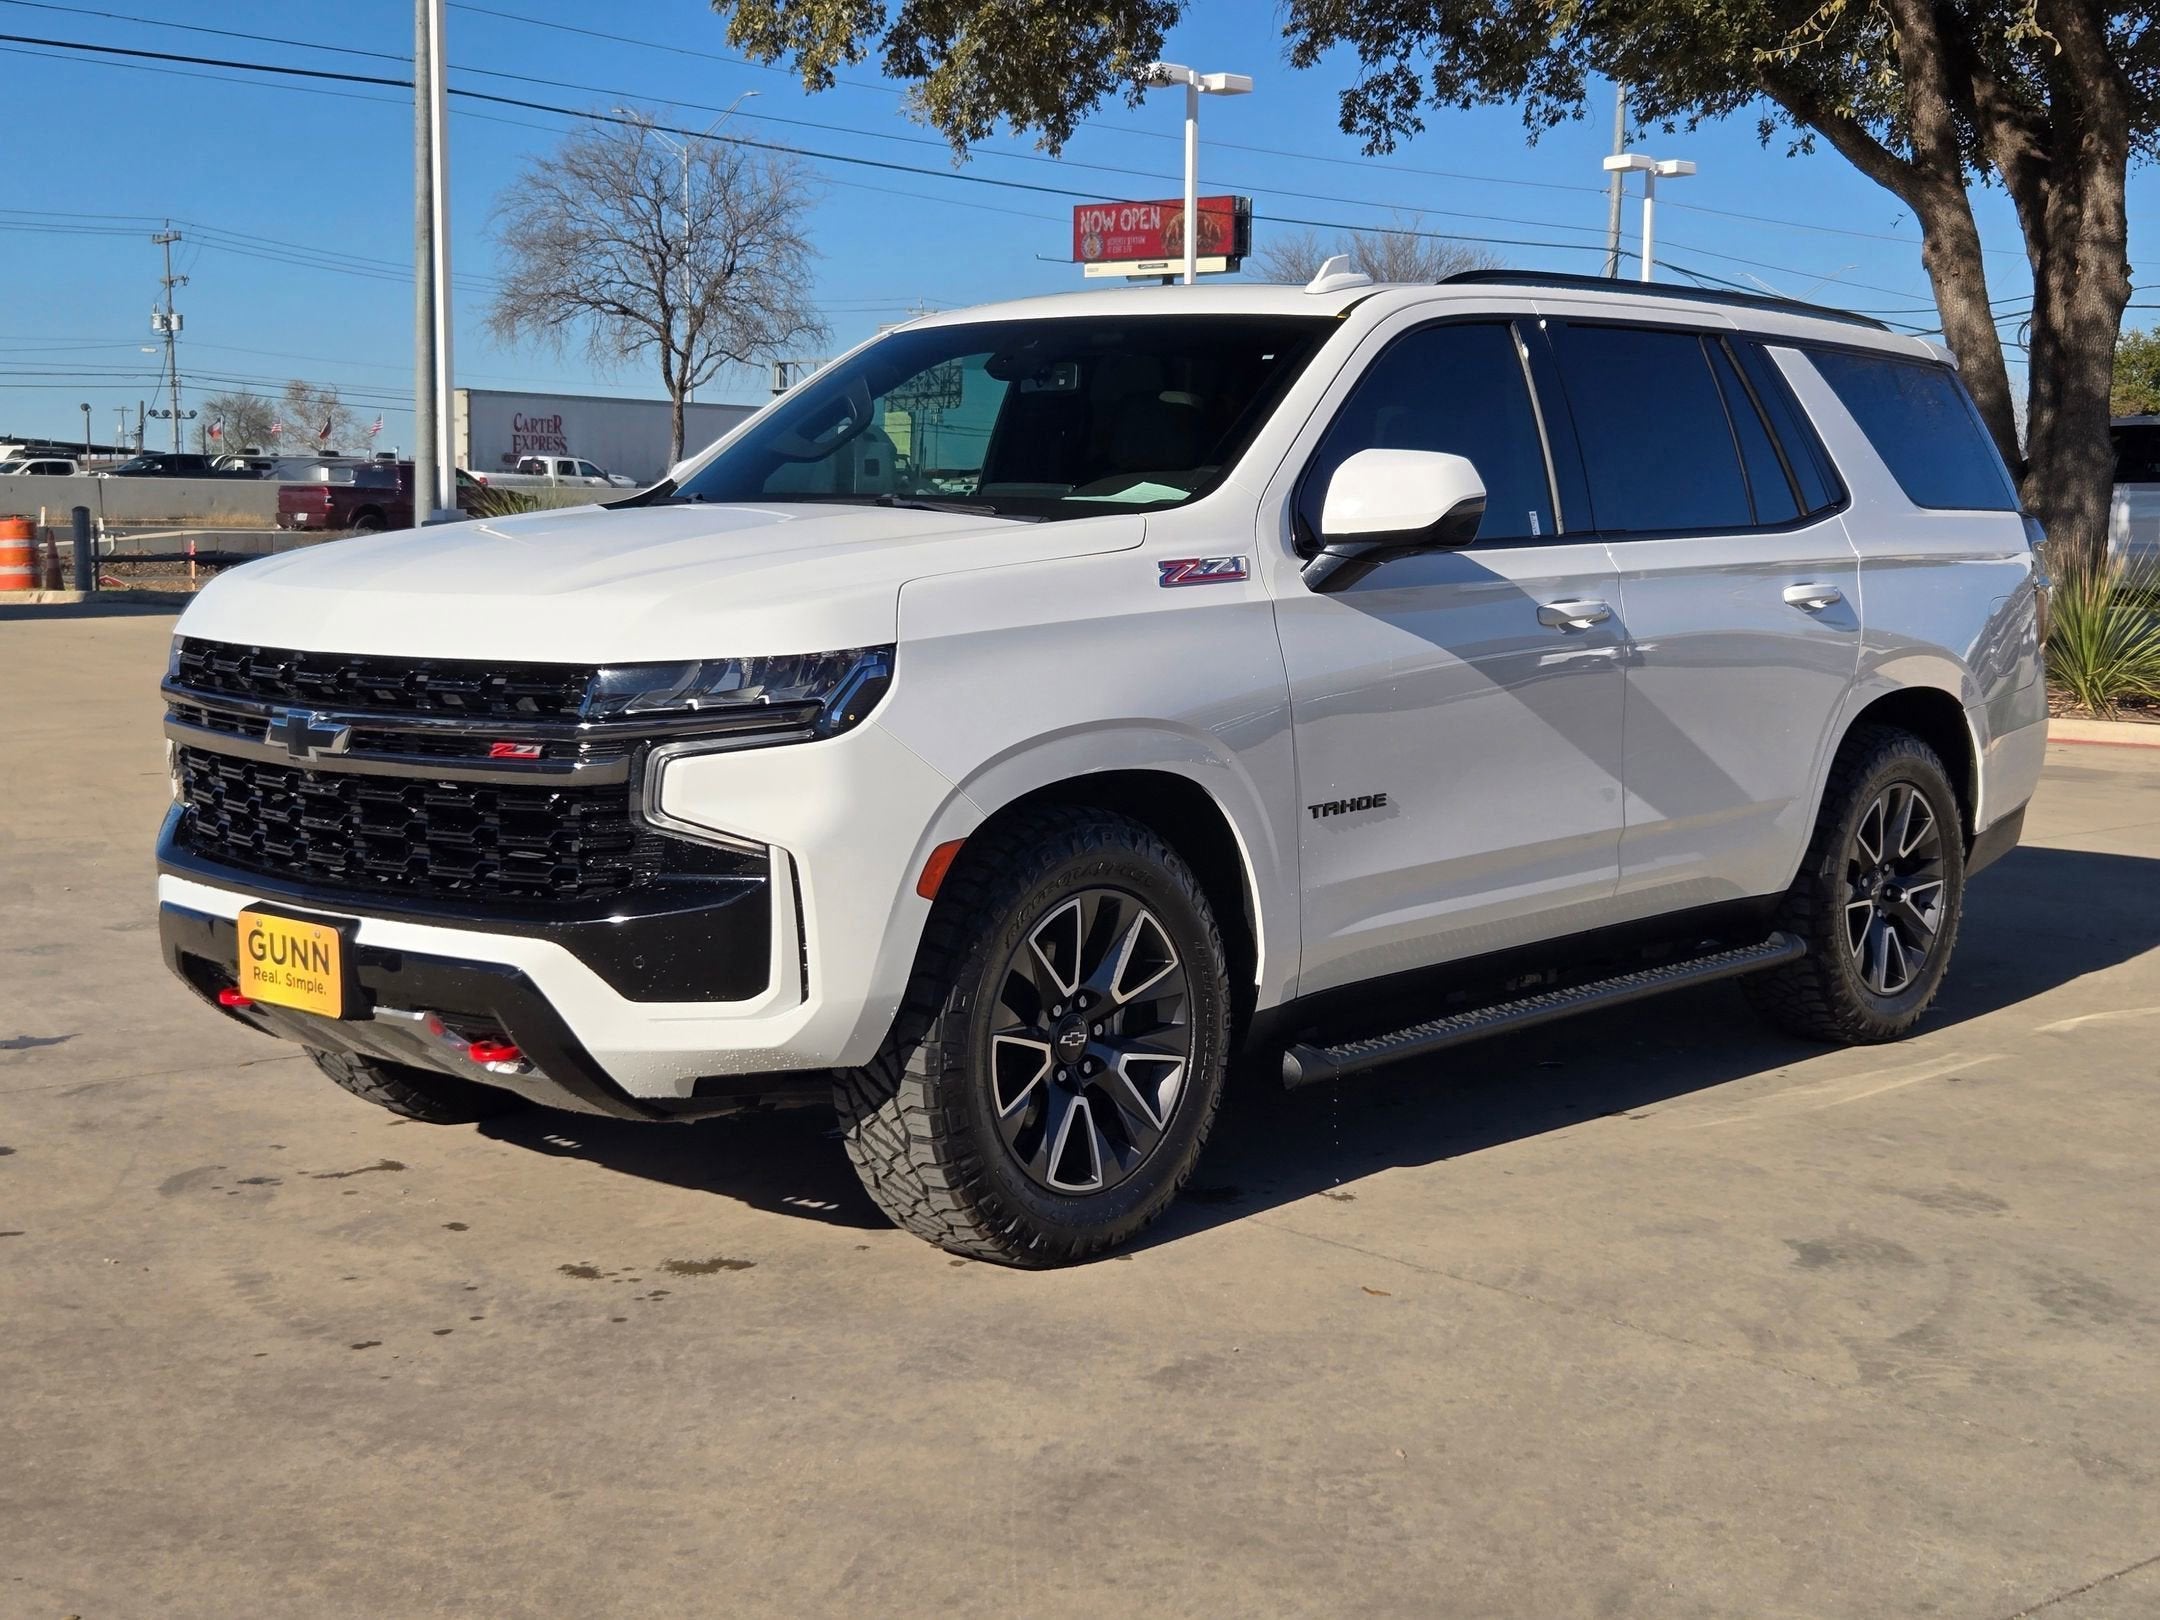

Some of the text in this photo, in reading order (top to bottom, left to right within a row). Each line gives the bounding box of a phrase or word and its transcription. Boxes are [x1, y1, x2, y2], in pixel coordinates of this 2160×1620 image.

[1080, 206, 1160, 234] NOW OPEN
[513, 412, 563, 435] CARTER
[511, 434, 568, 455] EXPRESS
[1158, 555, 1248, 588] Z71
[489, 742, 543, 759] Z71
[1307, 793, 1387, 819] TAHOE
[248, 928, 330, 976] GUNN
[253, 966, 327, 996] Real. Simple.
